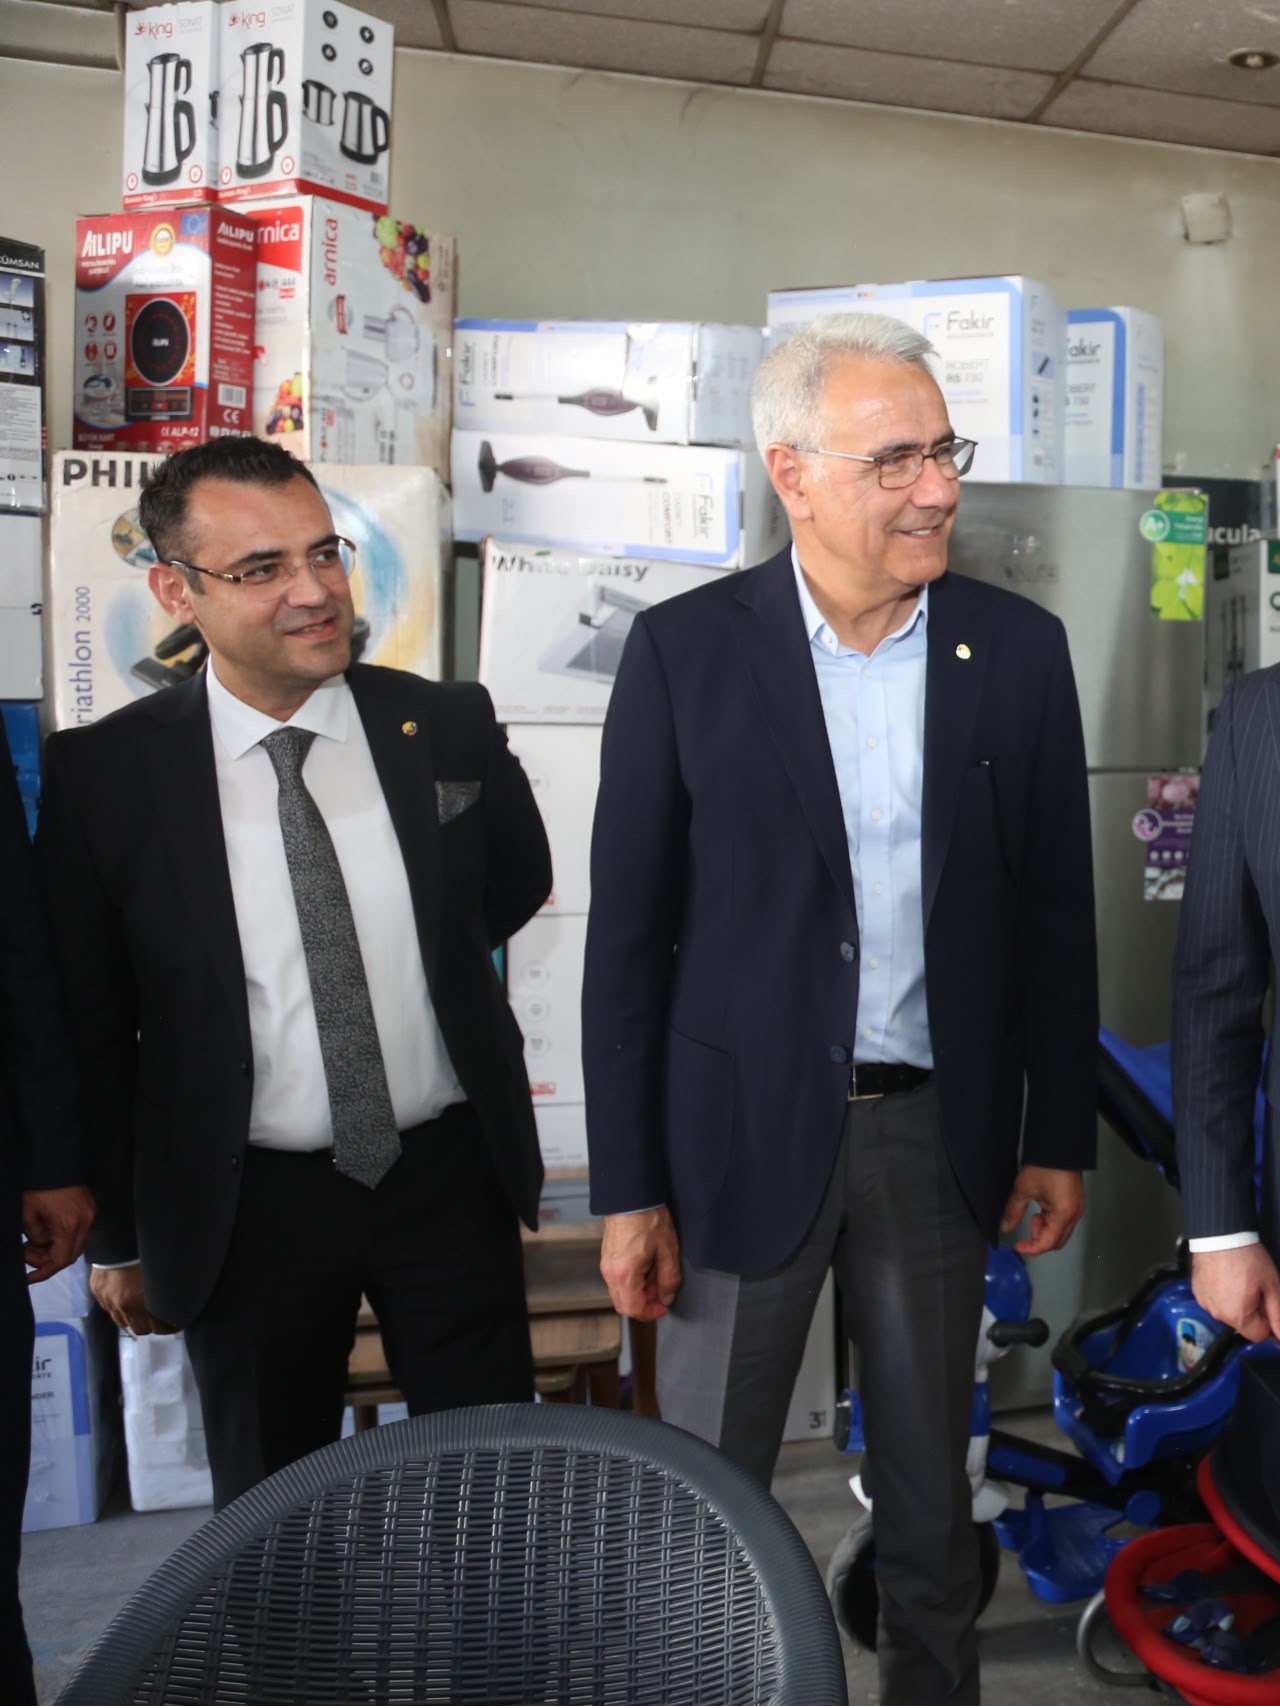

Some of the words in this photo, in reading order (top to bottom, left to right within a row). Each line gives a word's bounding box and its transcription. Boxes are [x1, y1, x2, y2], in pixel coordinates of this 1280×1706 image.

[149, 22, 173, 38] king
[242, 11, 266, 28] king
[258, 220, 300, 244] rnica
[0, 255, 40, 270] ÜMSAN
[947, 310, 995, 331] Fakir
[76, 586, 91, 622] 2000
[69, 632, 93, 728] riathlon
